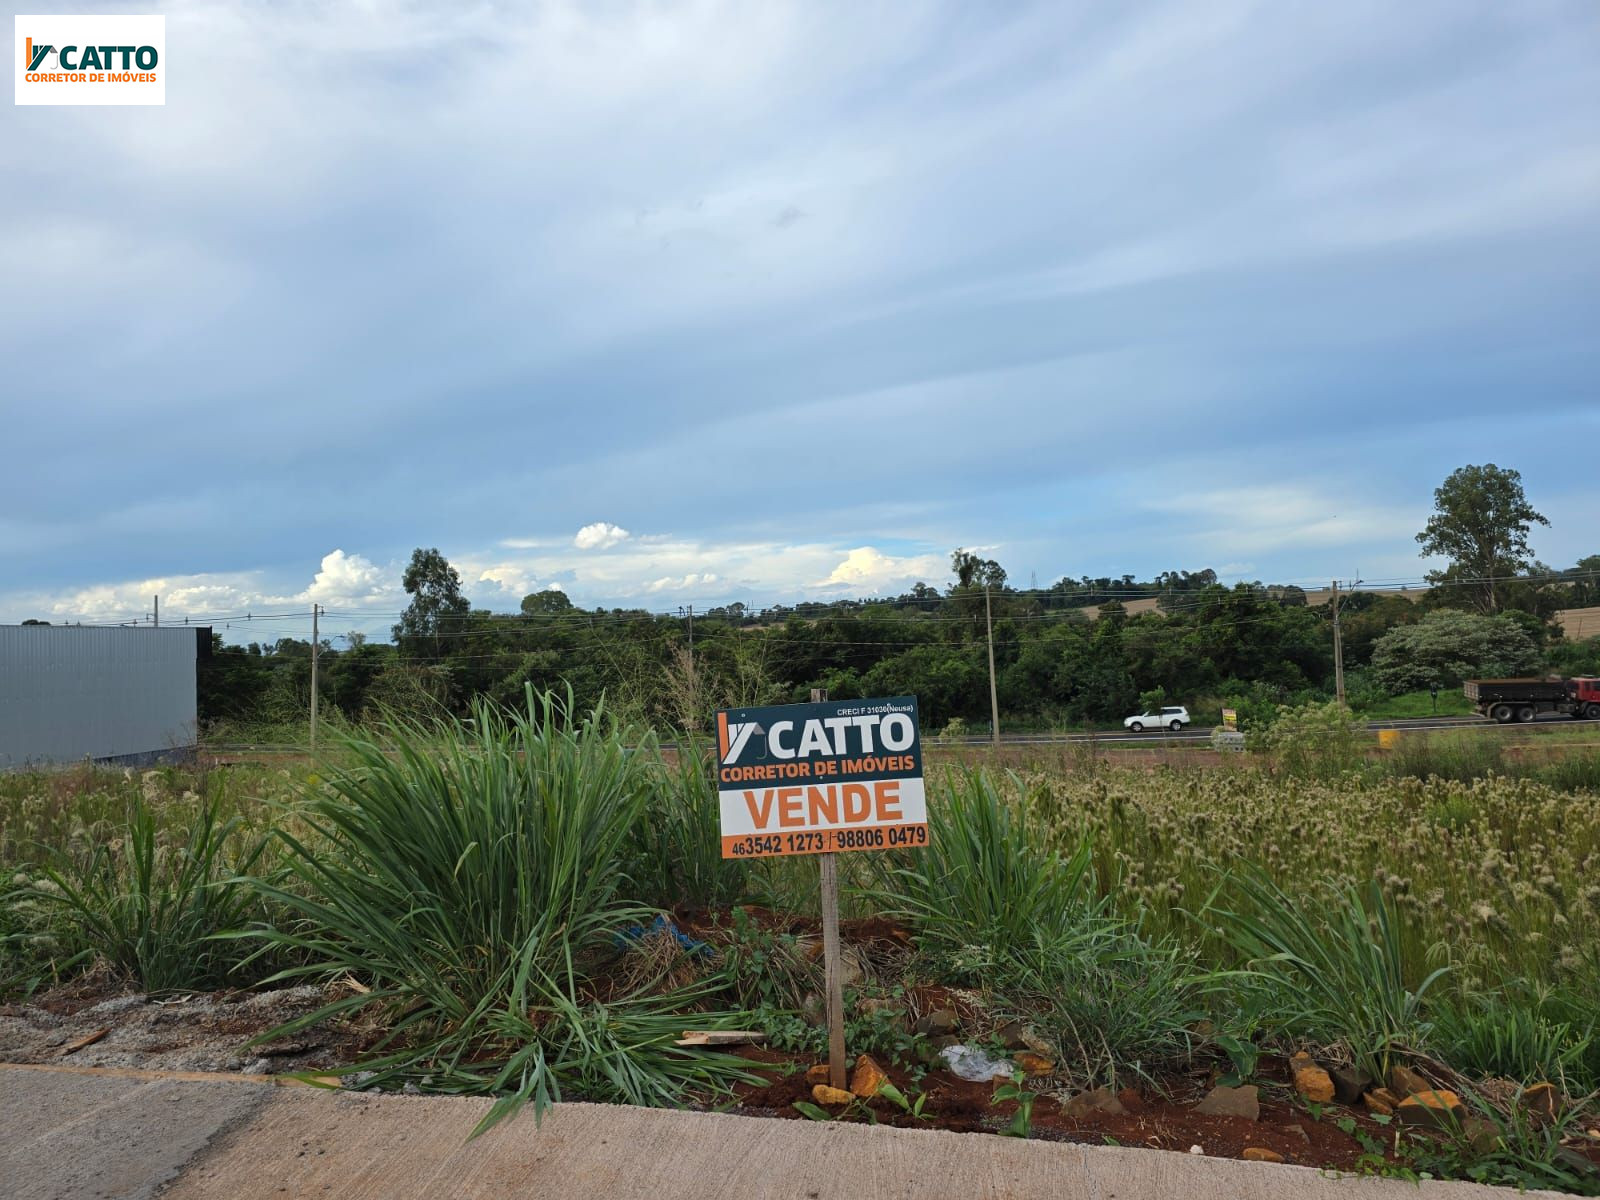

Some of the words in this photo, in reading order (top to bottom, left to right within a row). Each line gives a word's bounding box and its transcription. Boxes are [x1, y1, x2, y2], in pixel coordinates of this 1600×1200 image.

[837, 708, 860, 716] CRECI
[768, 712, 915, 760] CATTO
[720, 762, 810, 783] CORRETOR
[814, 760, 837, 776] DE
[841, 755, 915, 774] IMÓVEIS
[743, 781, 903, 830] VENDE
[787, 832, 824, 852] 1273
[836, 828, 884, 849] 98806
[888, 826, 926, 846] 0479
